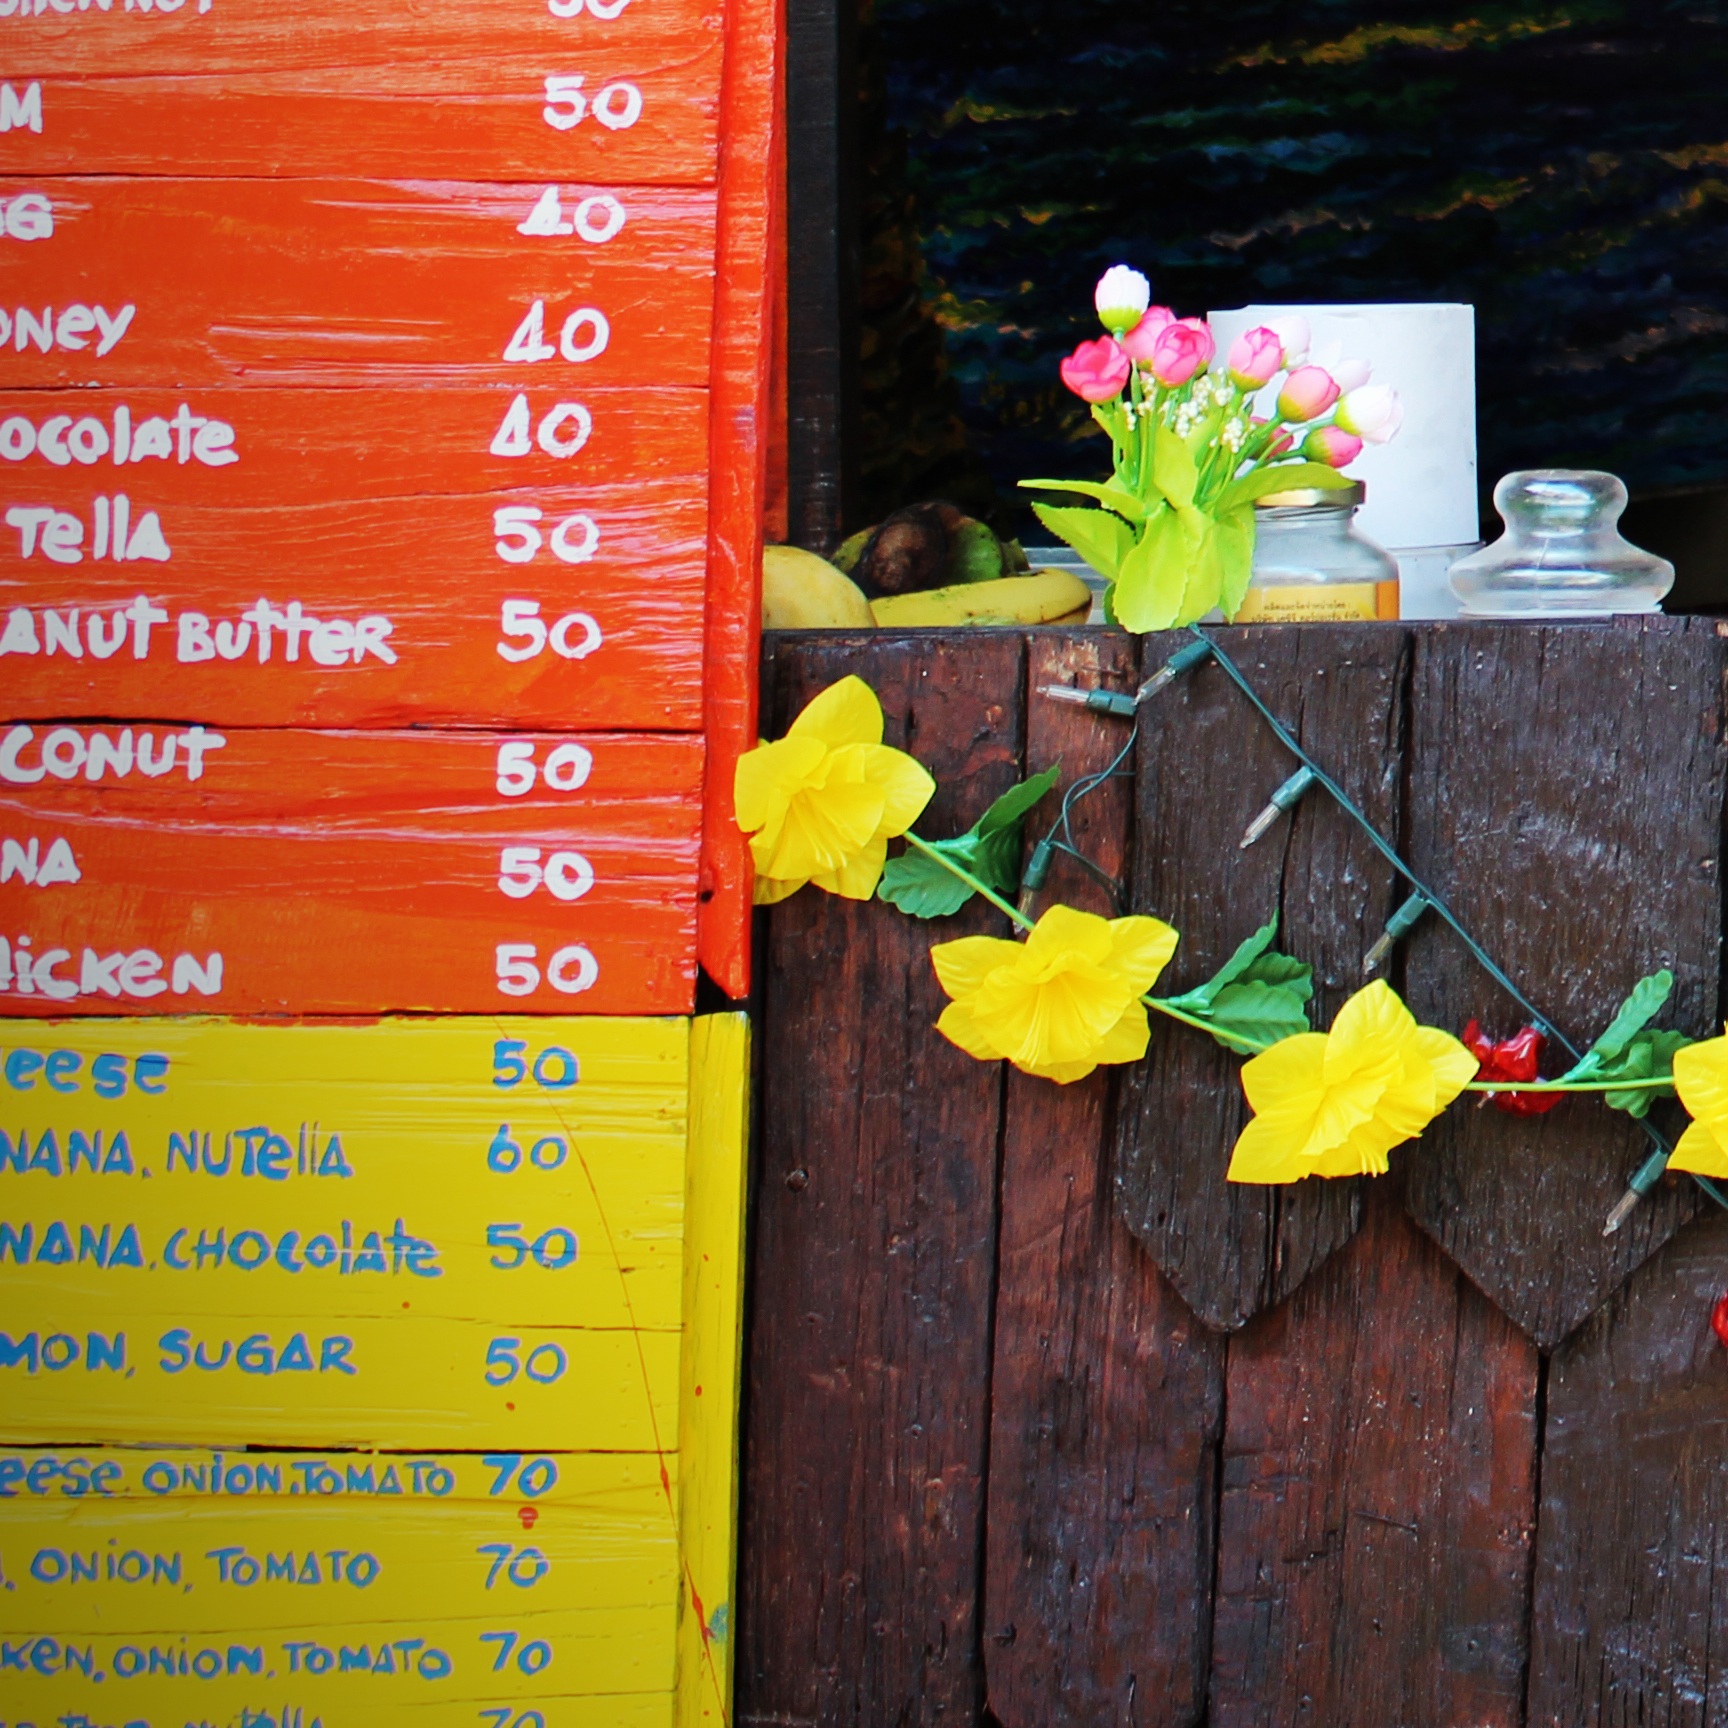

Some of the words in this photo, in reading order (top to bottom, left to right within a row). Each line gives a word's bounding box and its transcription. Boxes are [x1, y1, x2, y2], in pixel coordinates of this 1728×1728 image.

[543, 75, 642, 131] 50
[516, 185, 626, 243] 40
[501, 299, 610, 364] 40
[489, 393, 591, 460] 40
[493, 505, 599, 564] 50
[496, 598, 603, 663] 50
[496, 742, 593, 796] 50
[496, 846, 593, 901] 50
[494, 943, 598, 996] 50
[492, 1039, 580, 1091] 50
[486, 1123, 568, 1174] 60
[484, 1221, 578, 1270] 50
[158, 1327, 358, 1376] SUGAR
[483, 1337, 568, 1386] 50
[483, 1455, 557, 1498] 70
[205, 1546, 383, 1590] TOMATO
[476, 1543, 550, 1590] 70
[282, 1637, 453, 1681] TOMATO
[479, 1630, 552, 1675] 70
